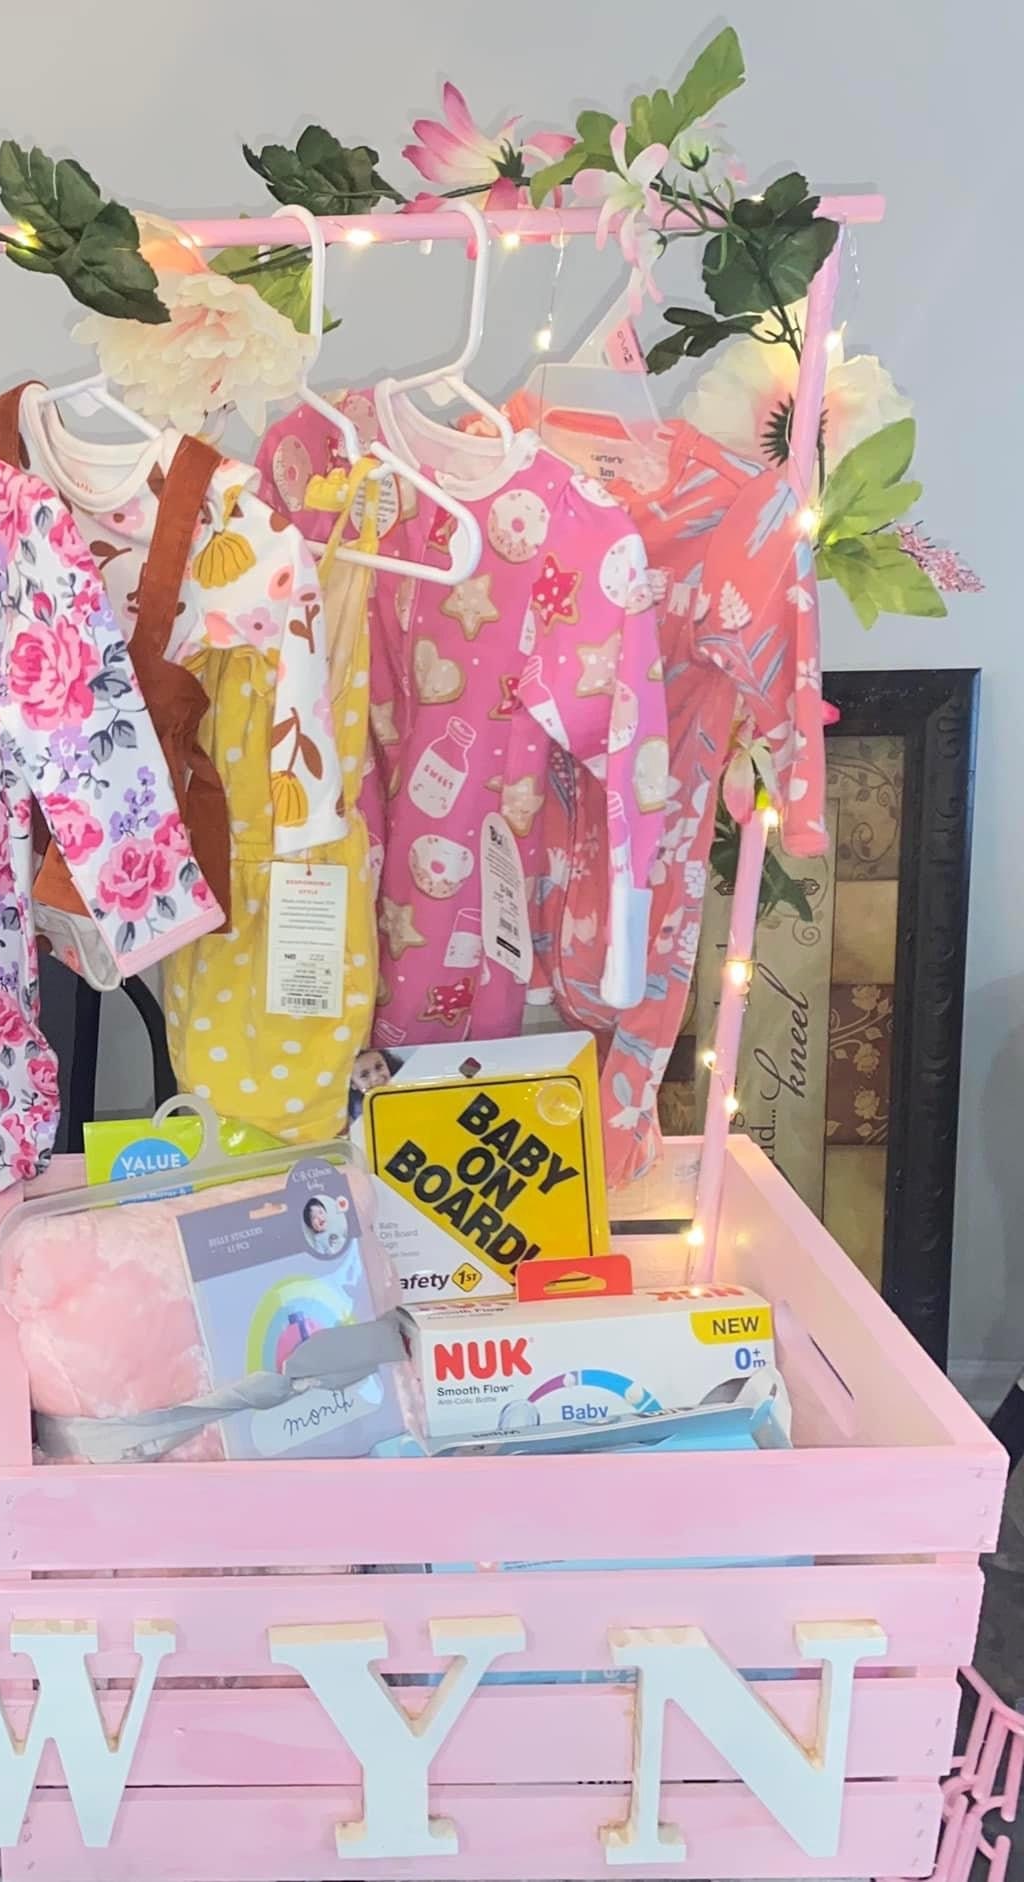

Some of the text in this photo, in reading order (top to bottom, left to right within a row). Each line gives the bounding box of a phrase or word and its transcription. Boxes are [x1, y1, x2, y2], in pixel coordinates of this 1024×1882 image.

[753, 961, 810, 1101] kneel
[120, 1153, 181, 1172] VALUE
[457, 1092, 580, 1195] BABY
[457, 1146, 528, 1212] ON
[400, 1272, 450, 1290] afety
[712, 1315, 760, 1336] NEW
[433, 1337, 533, 1382] NUK
[437, 1383, 510, 1397] Smooth Flow
[282, 1390, 355, 1438] month
